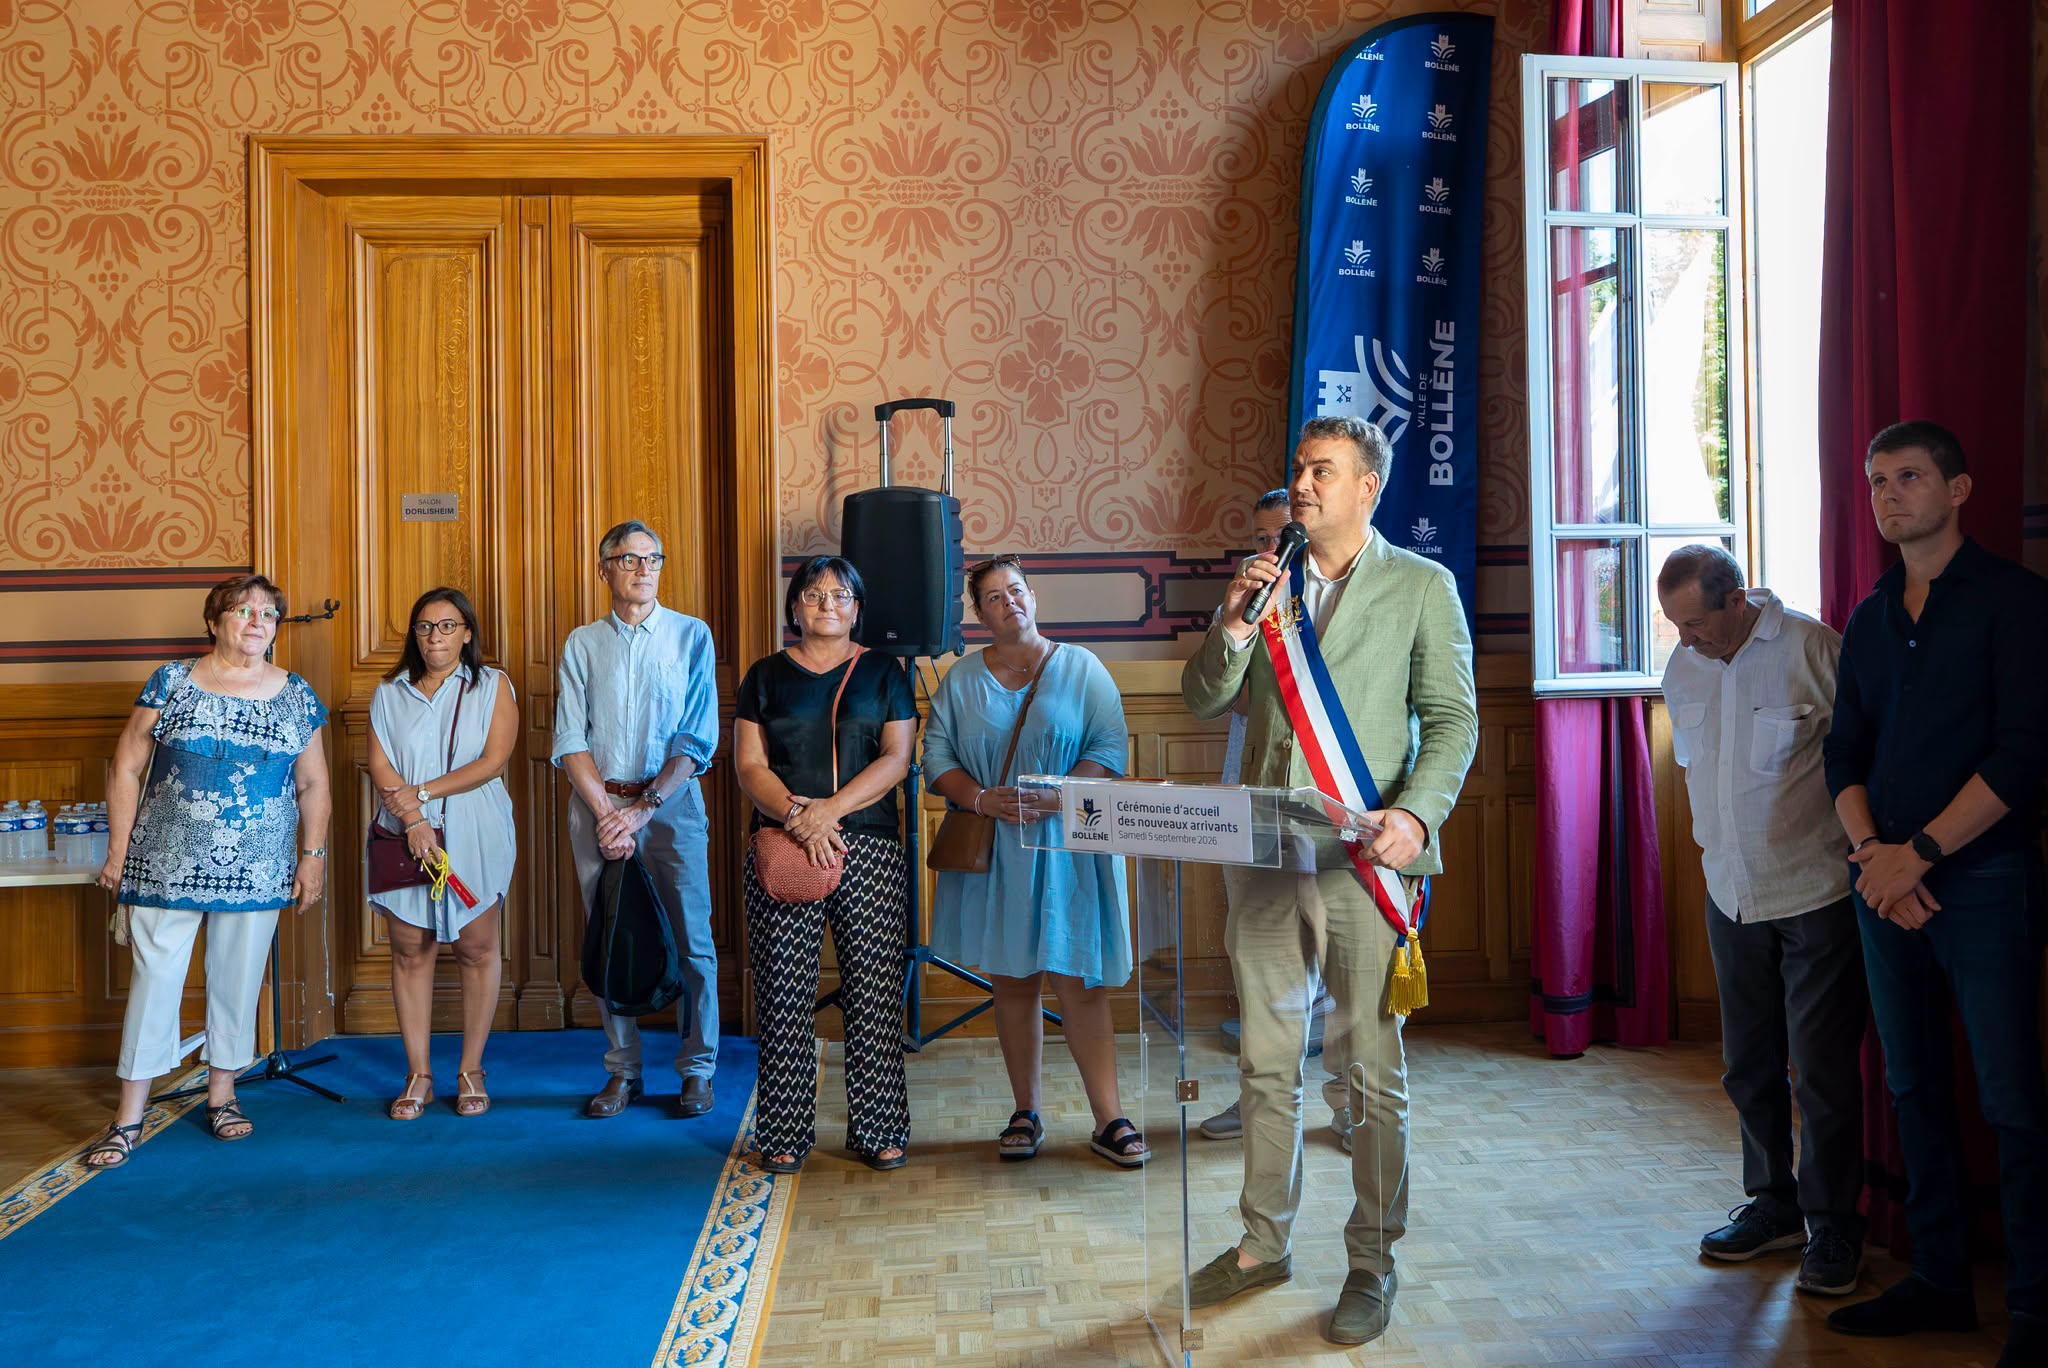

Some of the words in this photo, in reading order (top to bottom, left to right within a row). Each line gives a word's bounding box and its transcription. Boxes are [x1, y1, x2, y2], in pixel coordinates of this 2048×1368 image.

[1419, 372, 1427, 391] DE
[1416, 393, 1426, 429] VILLE
[1429, 319, 1455, 486] BOLLÈNE
[1117, 800, 1171, 815] Cérémonie
[1173, 803, 1220, 817] d'accueil
[1118, 816, 1136, 827] des
[1138, 818, 1188, 830] nouveaux
[1190, 820, 1238, 833] arrivants
[1118, 830, 1147, 841] Samedi
[1148, 832, 1153, 841] 5
[1154, 833, 1197, 844] septembre
[1198, 835, 1218, 845] 2026
